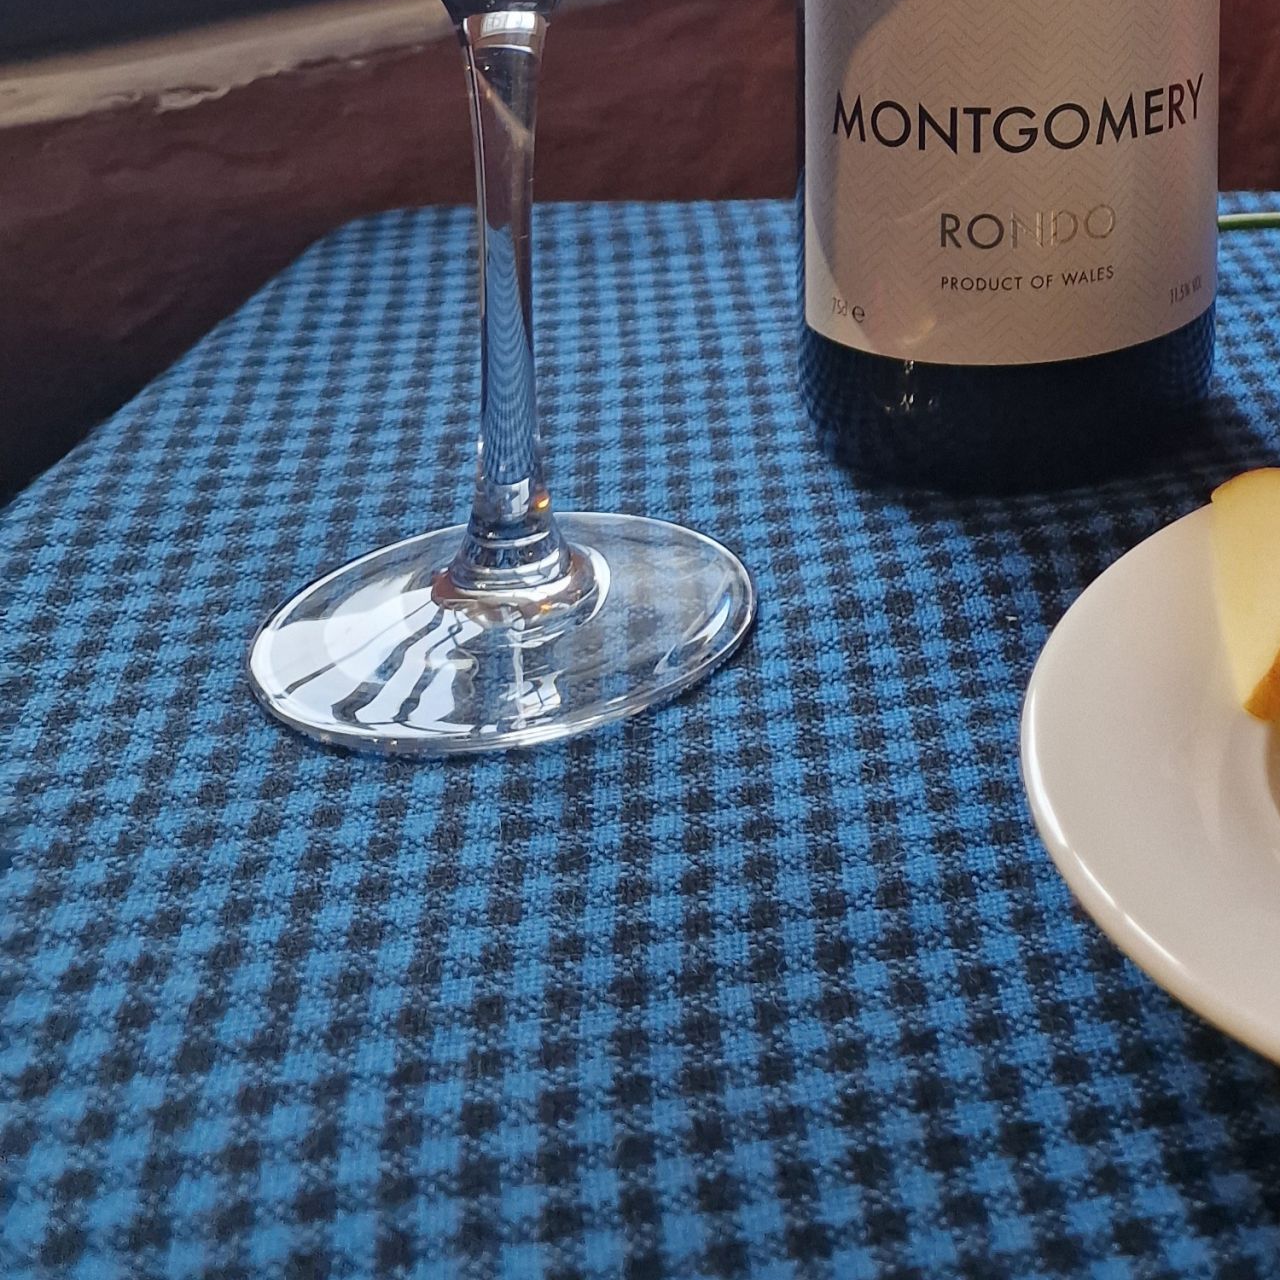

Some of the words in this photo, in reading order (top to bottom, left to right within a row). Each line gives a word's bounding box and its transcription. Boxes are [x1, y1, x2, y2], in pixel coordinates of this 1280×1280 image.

[832, 72, 1204, 154] MONTGOMERY
[940, 204, 1116, 250] RONDO
[941, 276, 1023, 291] PRODUCT
[1030, 275, 1053, 289] OF
[1061, 265, 1114, 286] WALES
